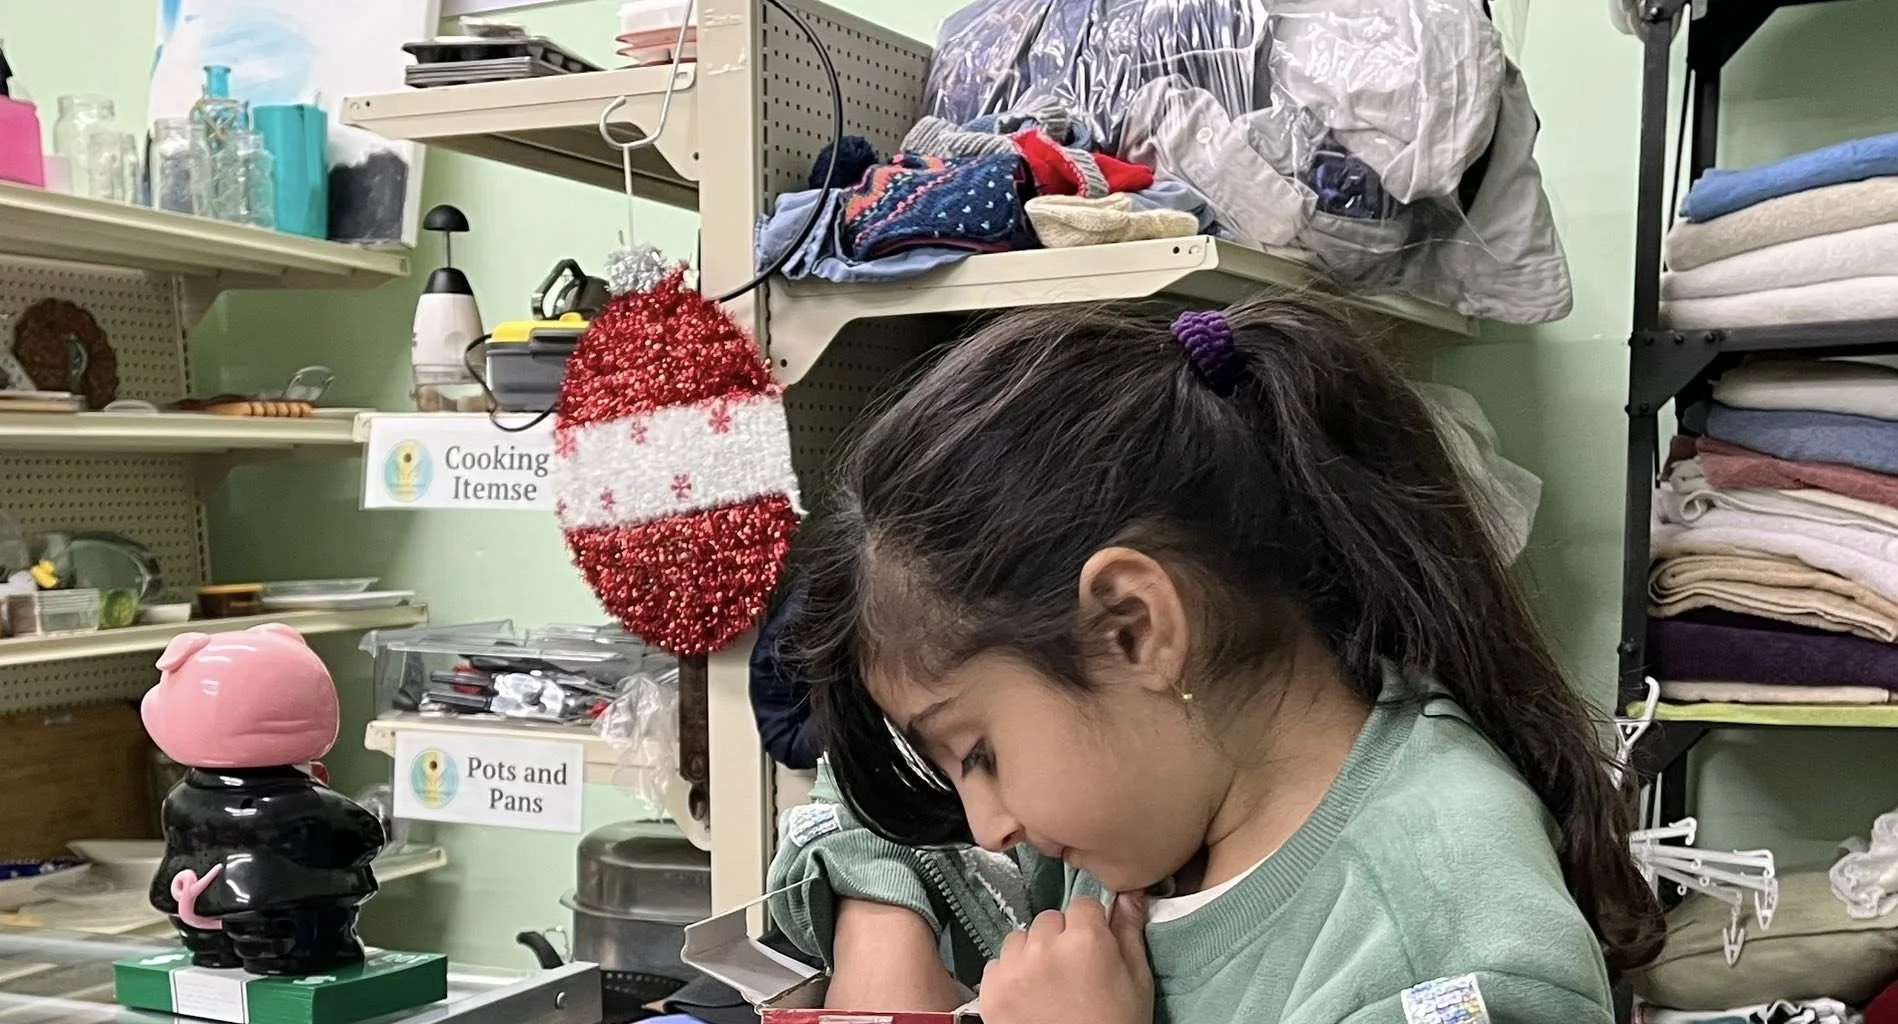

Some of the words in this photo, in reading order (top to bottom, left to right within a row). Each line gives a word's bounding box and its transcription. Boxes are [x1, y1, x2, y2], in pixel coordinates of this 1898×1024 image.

[445, 445, 550, 477] Cooking
[453, 476, 537, 501] Itemse
[467, 757, 517, 781] Pots
[524, 763, 567, 785] and
[489, 788, 543, 814] Pans
